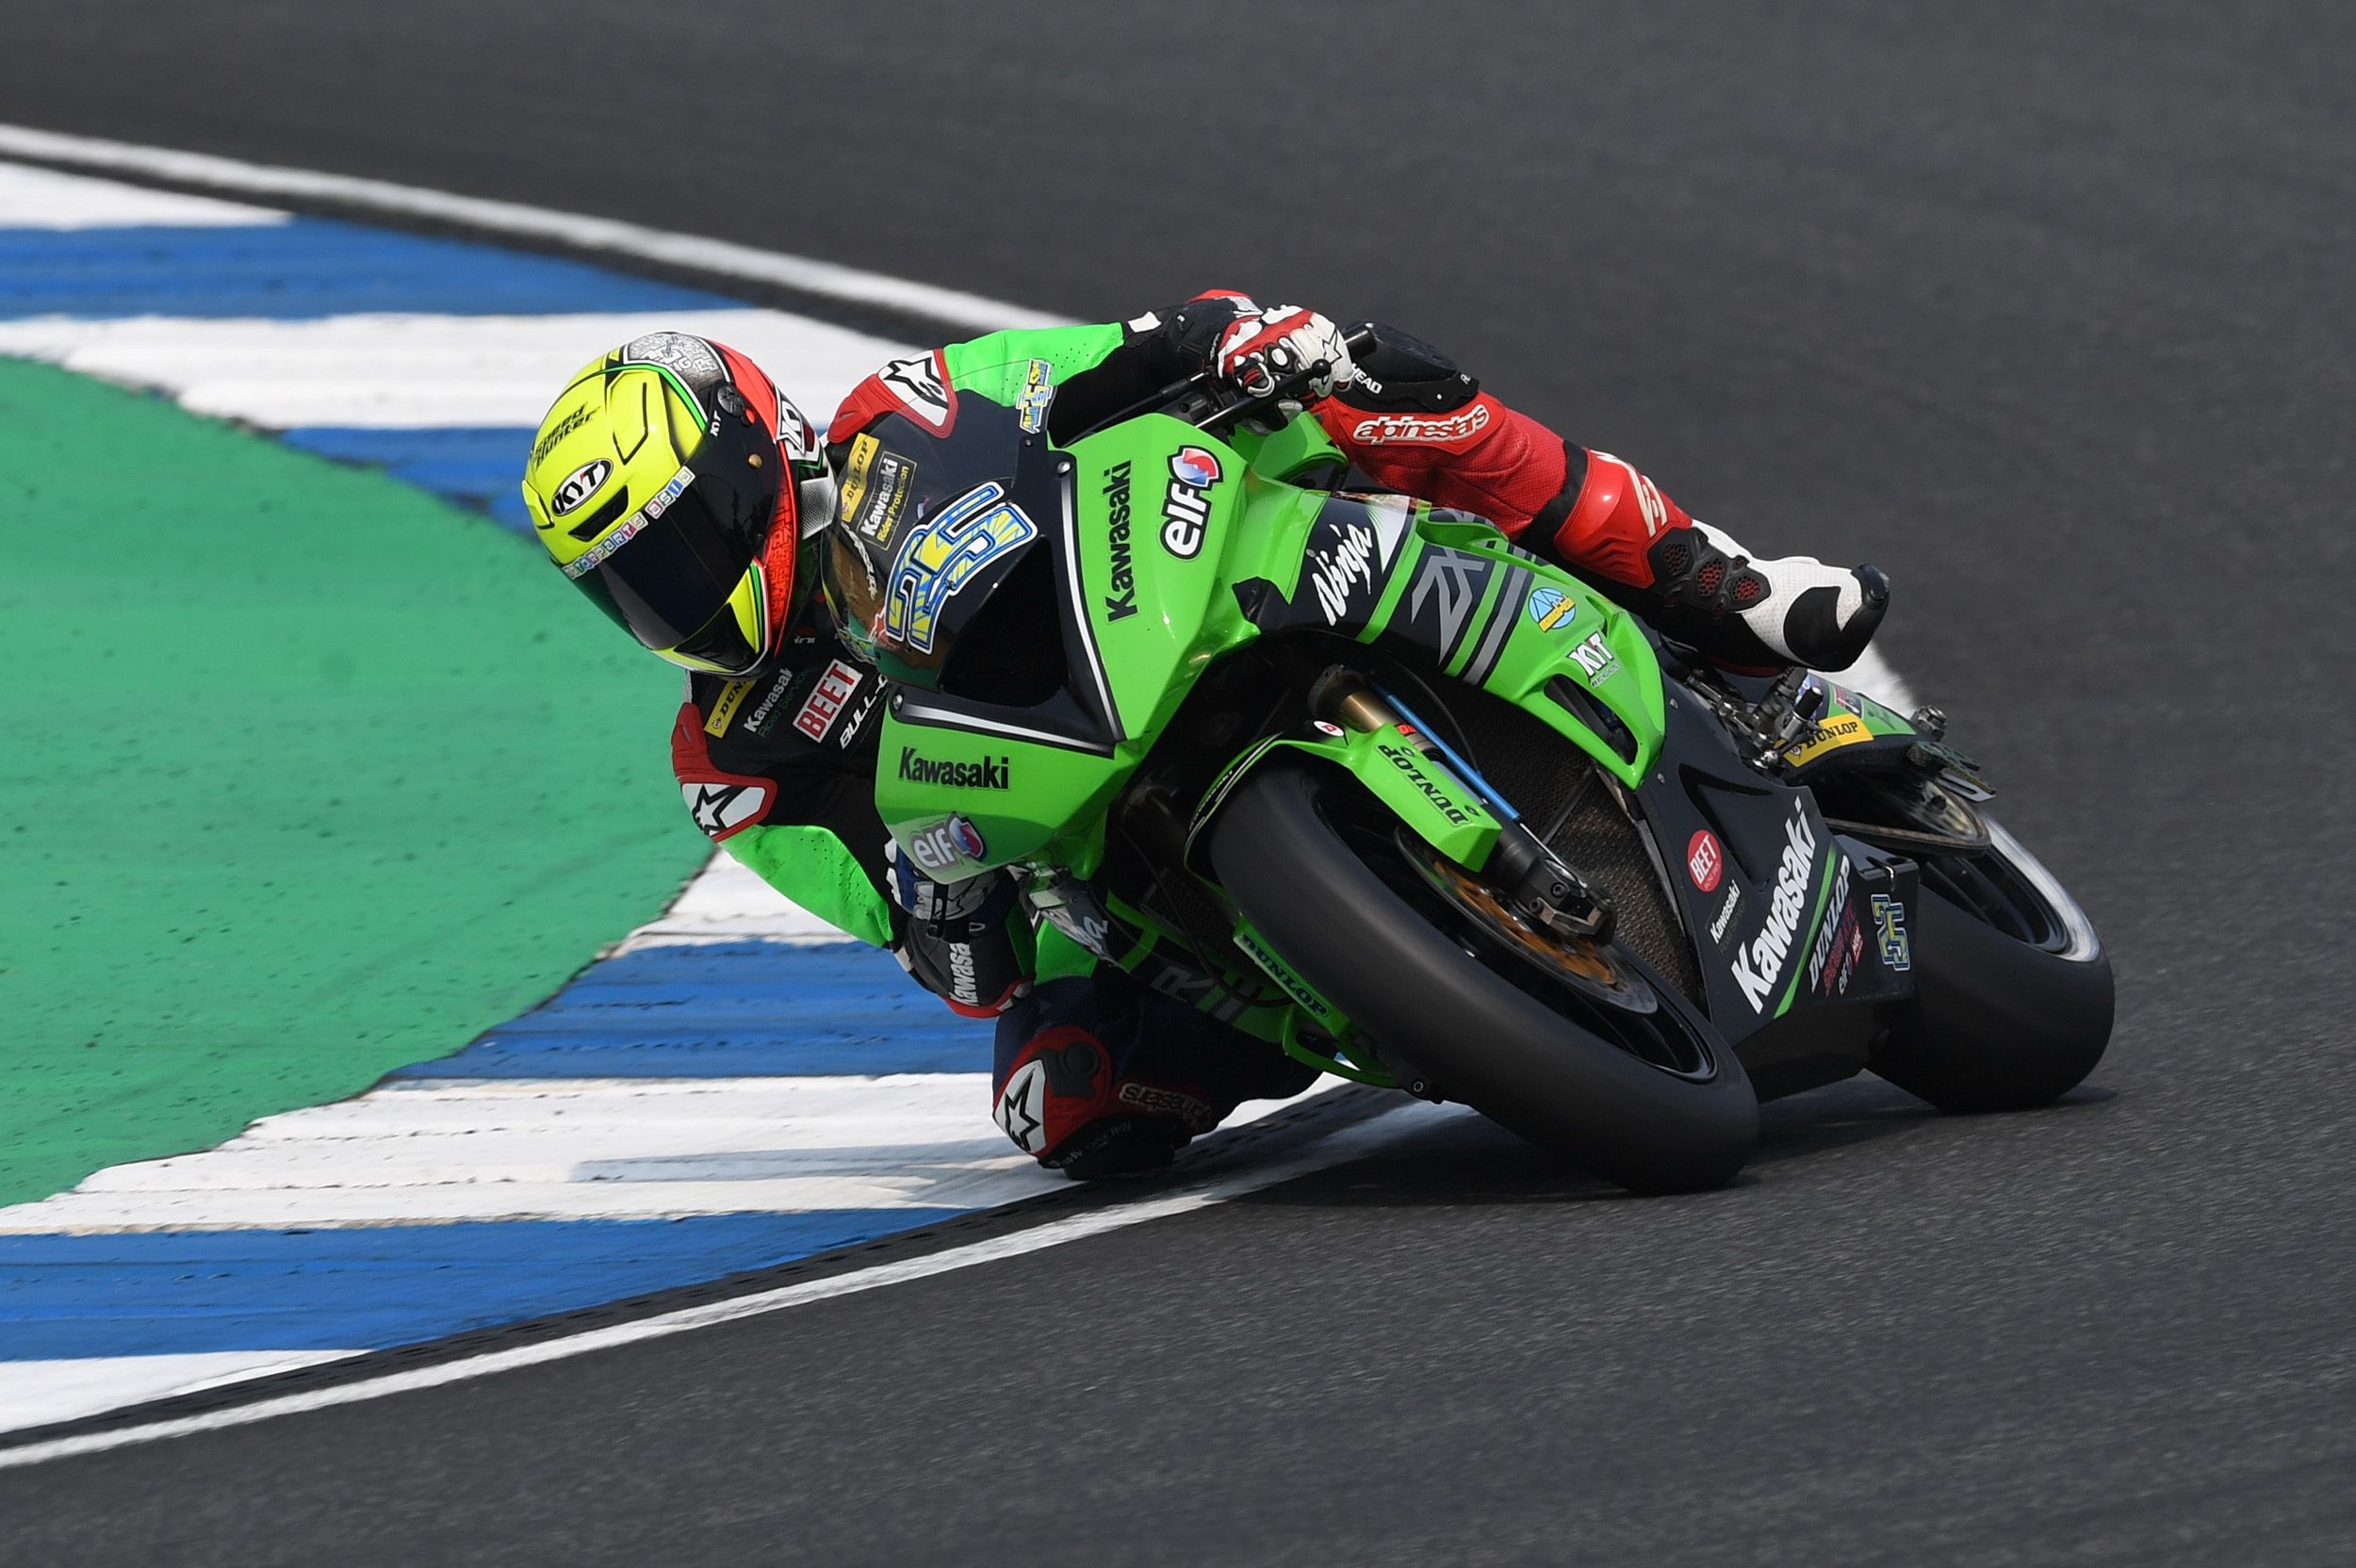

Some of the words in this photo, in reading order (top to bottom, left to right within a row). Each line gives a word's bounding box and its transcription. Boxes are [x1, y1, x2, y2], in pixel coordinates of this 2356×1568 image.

[553, 461, 599, 514] KYT
[860, 458, 898, 536] Kawasaki
[876, 515, 894, 542] Rider
[888, 466, 909, 516] Protection
[1164, 482, 1208, 556] elf
[886, 482, 1038, 655] 25
[1103, 460, 1138, 622] Kawasaki
[1311, 523, 1373, 627] Ninja
[1566, 631, 1613, 678] KYT
[744, 667, 794, 733] Kawasak
[798, 662, 856, 739] BEET
[1807, 721, 1858, 749] DUNLOP
[898, 745, 1010, 791] Kawasaki
[1377, 743, 1469, 825] DUNLOP
[912, 827, 956, 869] elf
[1690, 834, 1717, 885] BEET
[1710, 878, 1741, 945] Kawasaki
[1731, 794, 1817, 1016] Kawasaki
[1808, 854, 1851, 995] DUNLOP
[948, 942, 980, 1007] Kawasa
